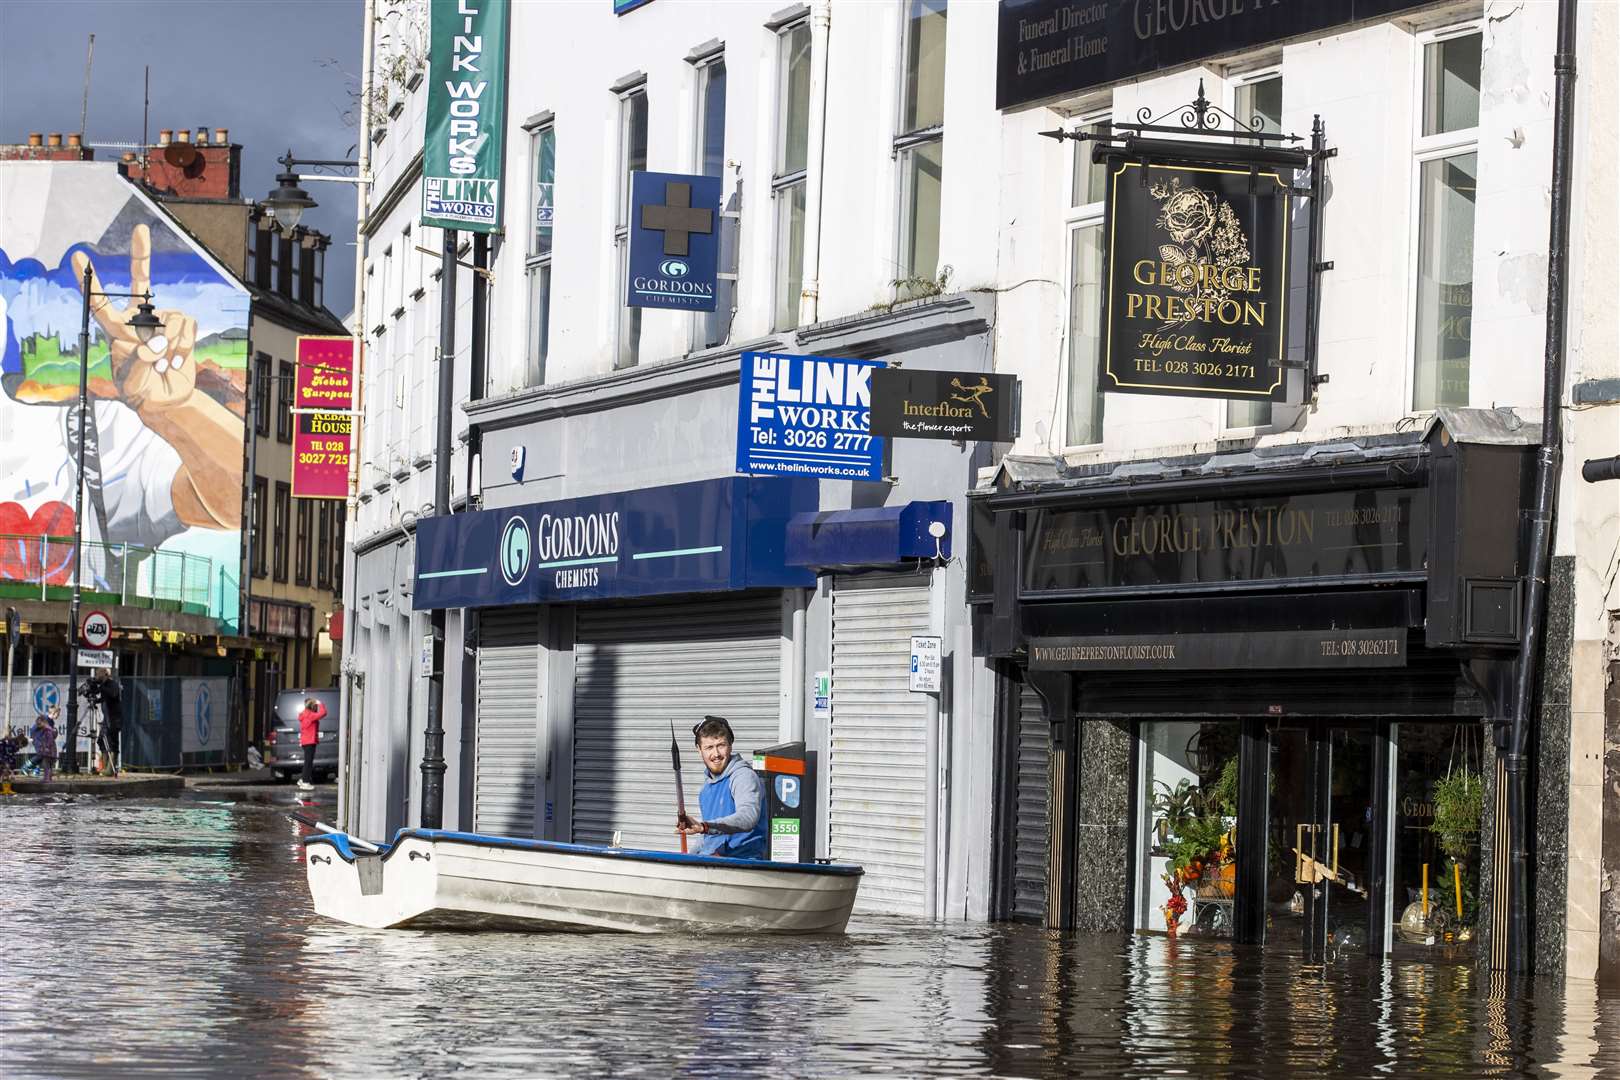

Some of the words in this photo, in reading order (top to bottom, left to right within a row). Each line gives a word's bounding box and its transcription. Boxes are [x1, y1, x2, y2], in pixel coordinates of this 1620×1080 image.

[453, 0, 481, 71] LINK
[1018, 7, 1060, 42] Funeral
[1017, 56, 1028, 76] &
[1030, 41, 1072, 72] Funeral
[1074, 35, 1108, 59] Home
[445, 81, 488, 174] WORKS
[426, 179, 440, 211] THE
[442, 180, 495, 204] LINK
[440, 202, 493, 217] WORKS
[634, 277, 712, 294] GORDONS
[1133, 259, 1261, 293] GEORGE
[1125, 293, 1267, 327] PRESTON
[1138, 333, 1177, 357] High
[1174, 335, 1207, 352] Class
[1209, 337, 1252, 355] Florist
[1165, 360, 1188, 374] 028
[1192, 361, 1222, 376] 3026
[1225, 364, 1255, 378] 2171
[750, 356, 777, 423] THE
[777, 358, 876, 407] LINK
[777, 405, 870, 432] WORKS
[903, 400, 973, 418] Interflora
[750, 426, 777, 445] Tel:
[783, 429, 827, 448] 3026
[833, 432, 873, 451] 2777
[903, 420, 917, 430] the
[917, 421, 942, 432] flower
[943, 424, 971, 436] experts
[299, 453, 326, 463] 3027
[311, 441, 323, 450] TEL
[325, 441, 344, 451] 028
[749, 462, 870, 477] www.thelinkworks.co.uk
[538, 512, 619, 560] GORDONS
[1113, 512, 1201, 556] GEORGE
[1210, 502, 1314, 550] PRESTON
[555, 567, 599, 589] CHEMISTS
[1320, 641, 1339, 656] TEL:
[1341, 640, 1357, 655] 028
[1357, 639, 1399, 655] 30262171
[912, 656, 918, 672] P
[781, 778, 797, 802] P
[773, 824, 798, 833] 3550
